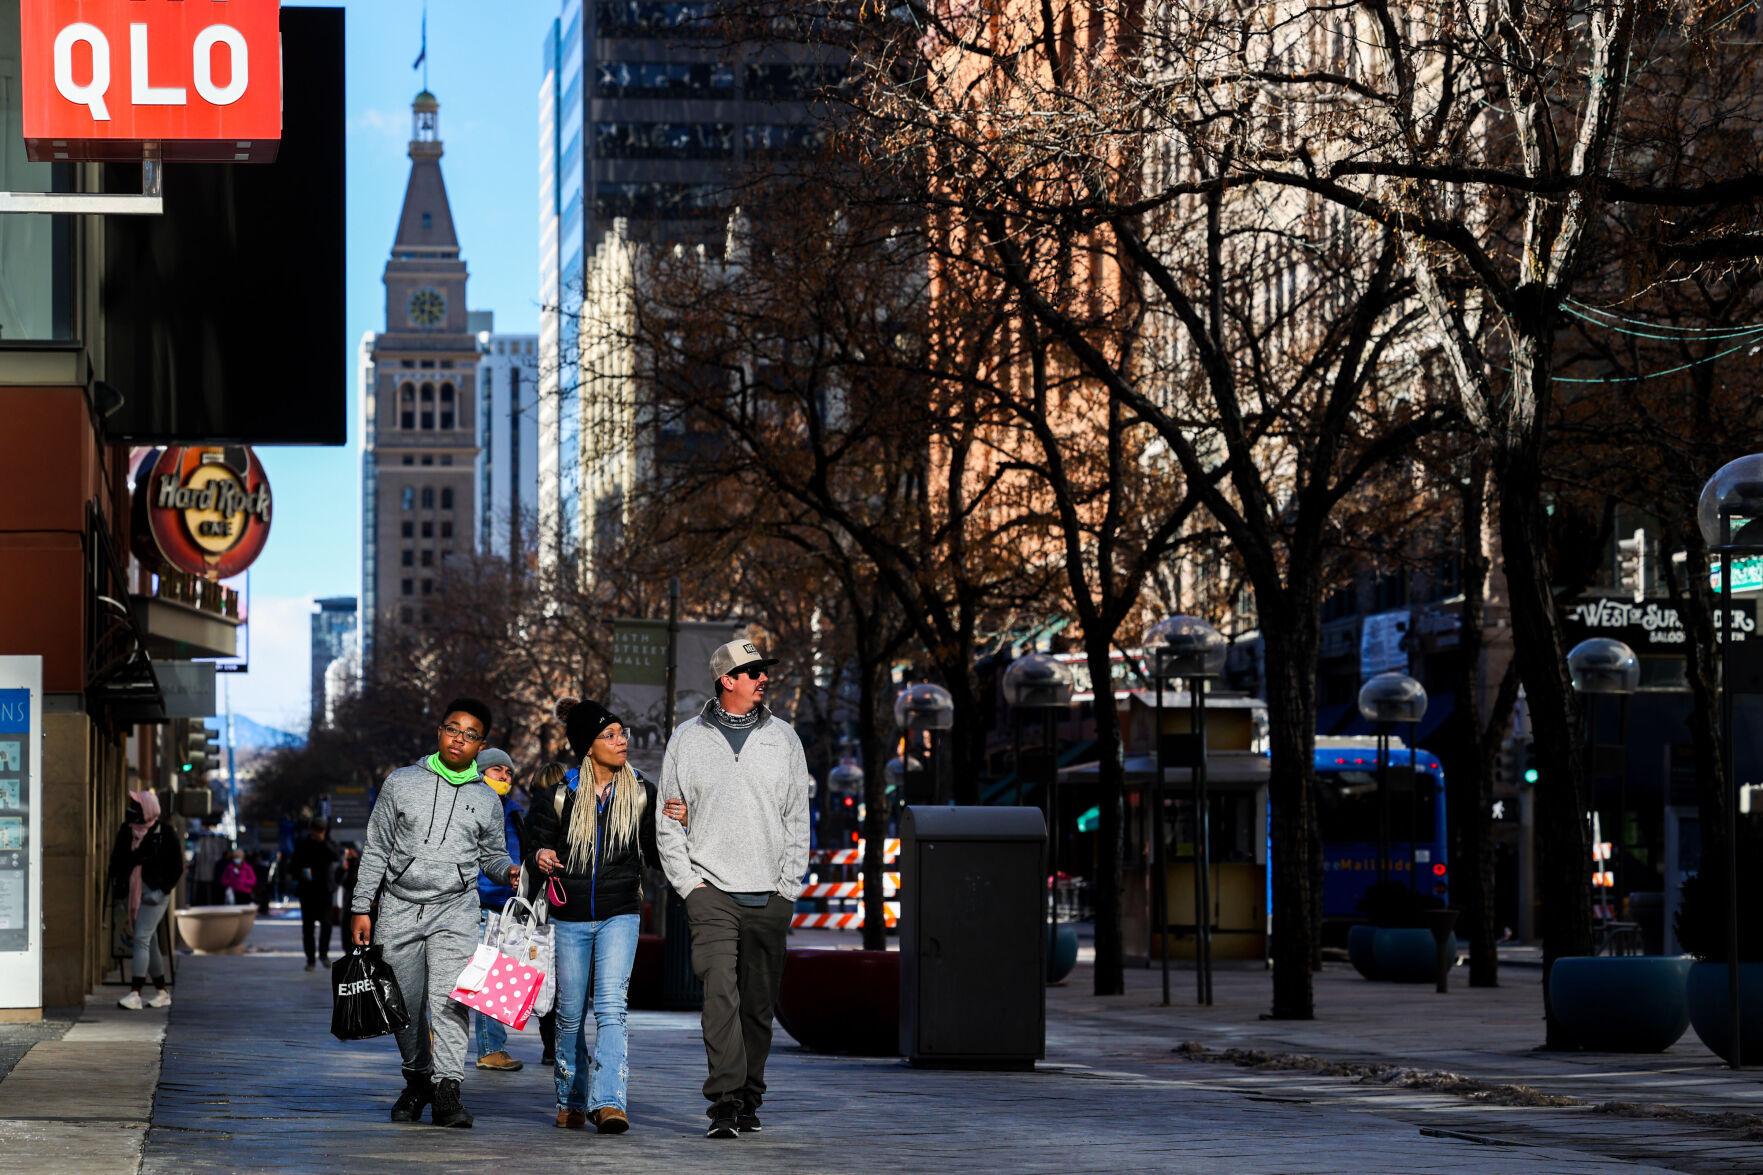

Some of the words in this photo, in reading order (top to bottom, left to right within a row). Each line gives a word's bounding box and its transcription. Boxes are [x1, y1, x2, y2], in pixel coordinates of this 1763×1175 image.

[53, 22, 249, 121] QLO
[158, 474, 216, 509] Hard
[217, 478, 271, 522] Rock
[199, 520, 233, 537] CAFE
[1649, 631, 1686, 644] SALOO
[614, 644, 667, 656] STREET
[613, 656, 651, 667] MALL
